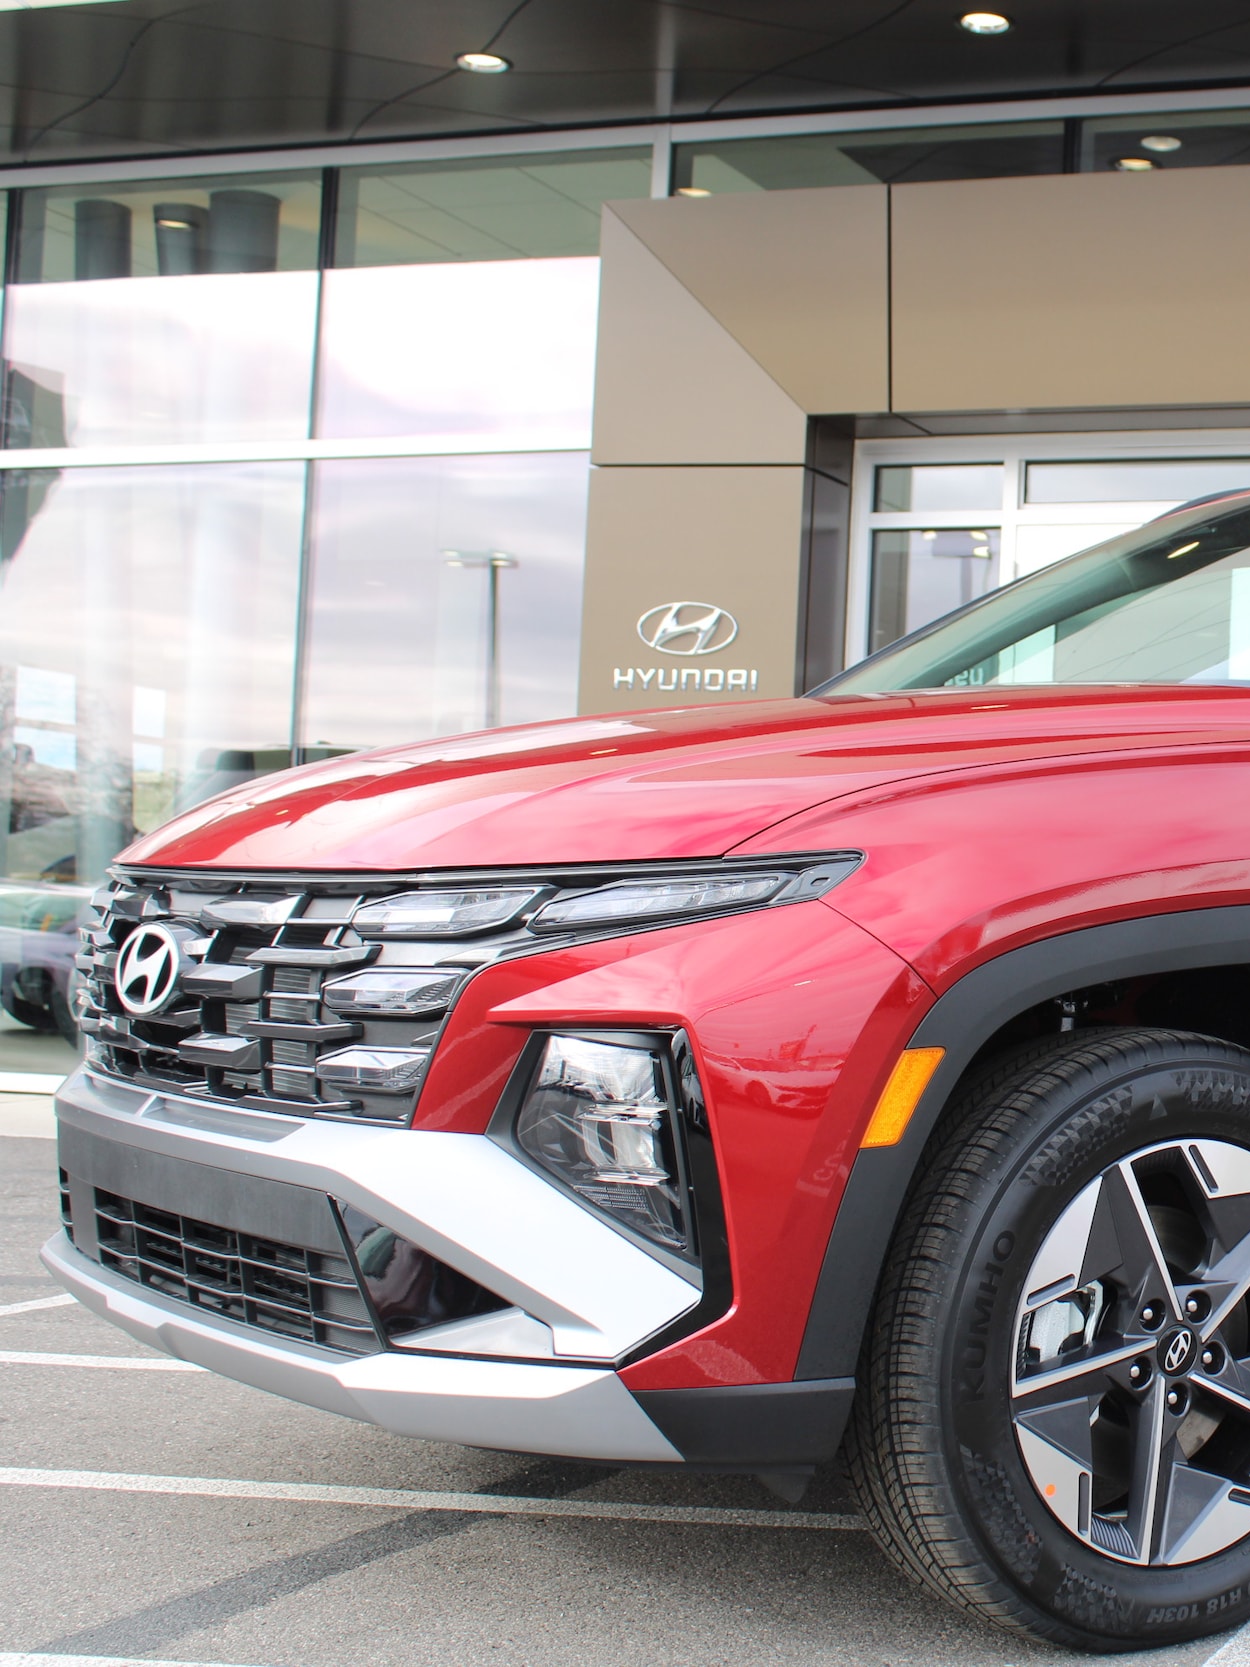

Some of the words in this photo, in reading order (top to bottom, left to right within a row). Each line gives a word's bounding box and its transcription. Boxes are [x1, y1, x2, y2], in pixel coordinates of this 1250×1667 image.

[613, 667, 758, 692] HYUNDAI
[958, 1230, 1016, 1403] KUMHO
[1146, 1602, 1200, 1625] 103H
[1206, 1586, 1242, 1615] R18
